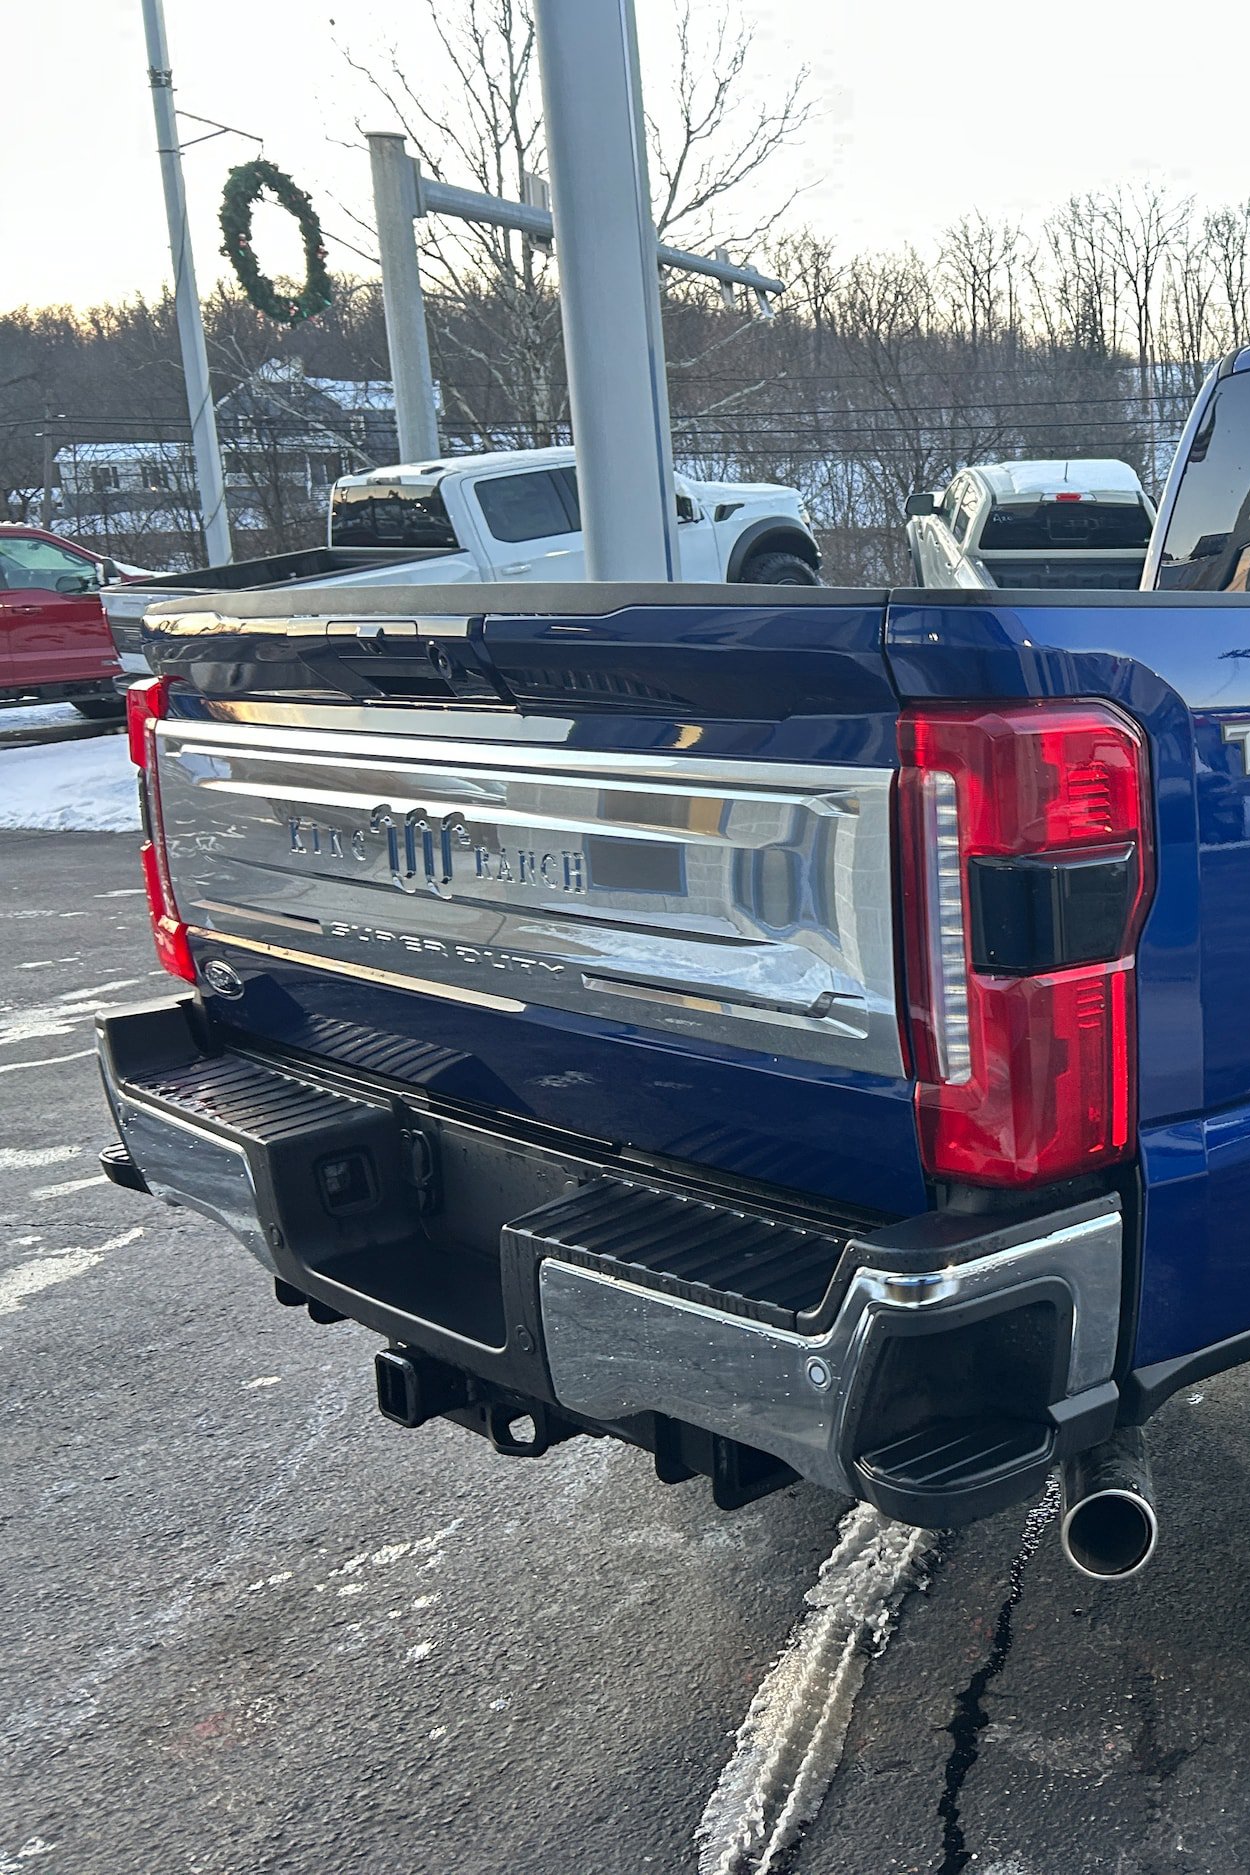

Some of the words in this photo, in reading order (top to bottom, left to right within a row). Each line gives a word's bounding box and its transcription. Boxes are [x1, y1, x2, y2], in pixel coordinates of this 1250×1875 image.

[289, 815, 367, 862] KING
[473, 843, 587, 895] RANCH
[329, 920, 449, 958] SUPER
[454, 945, 565, 981] DUTY
